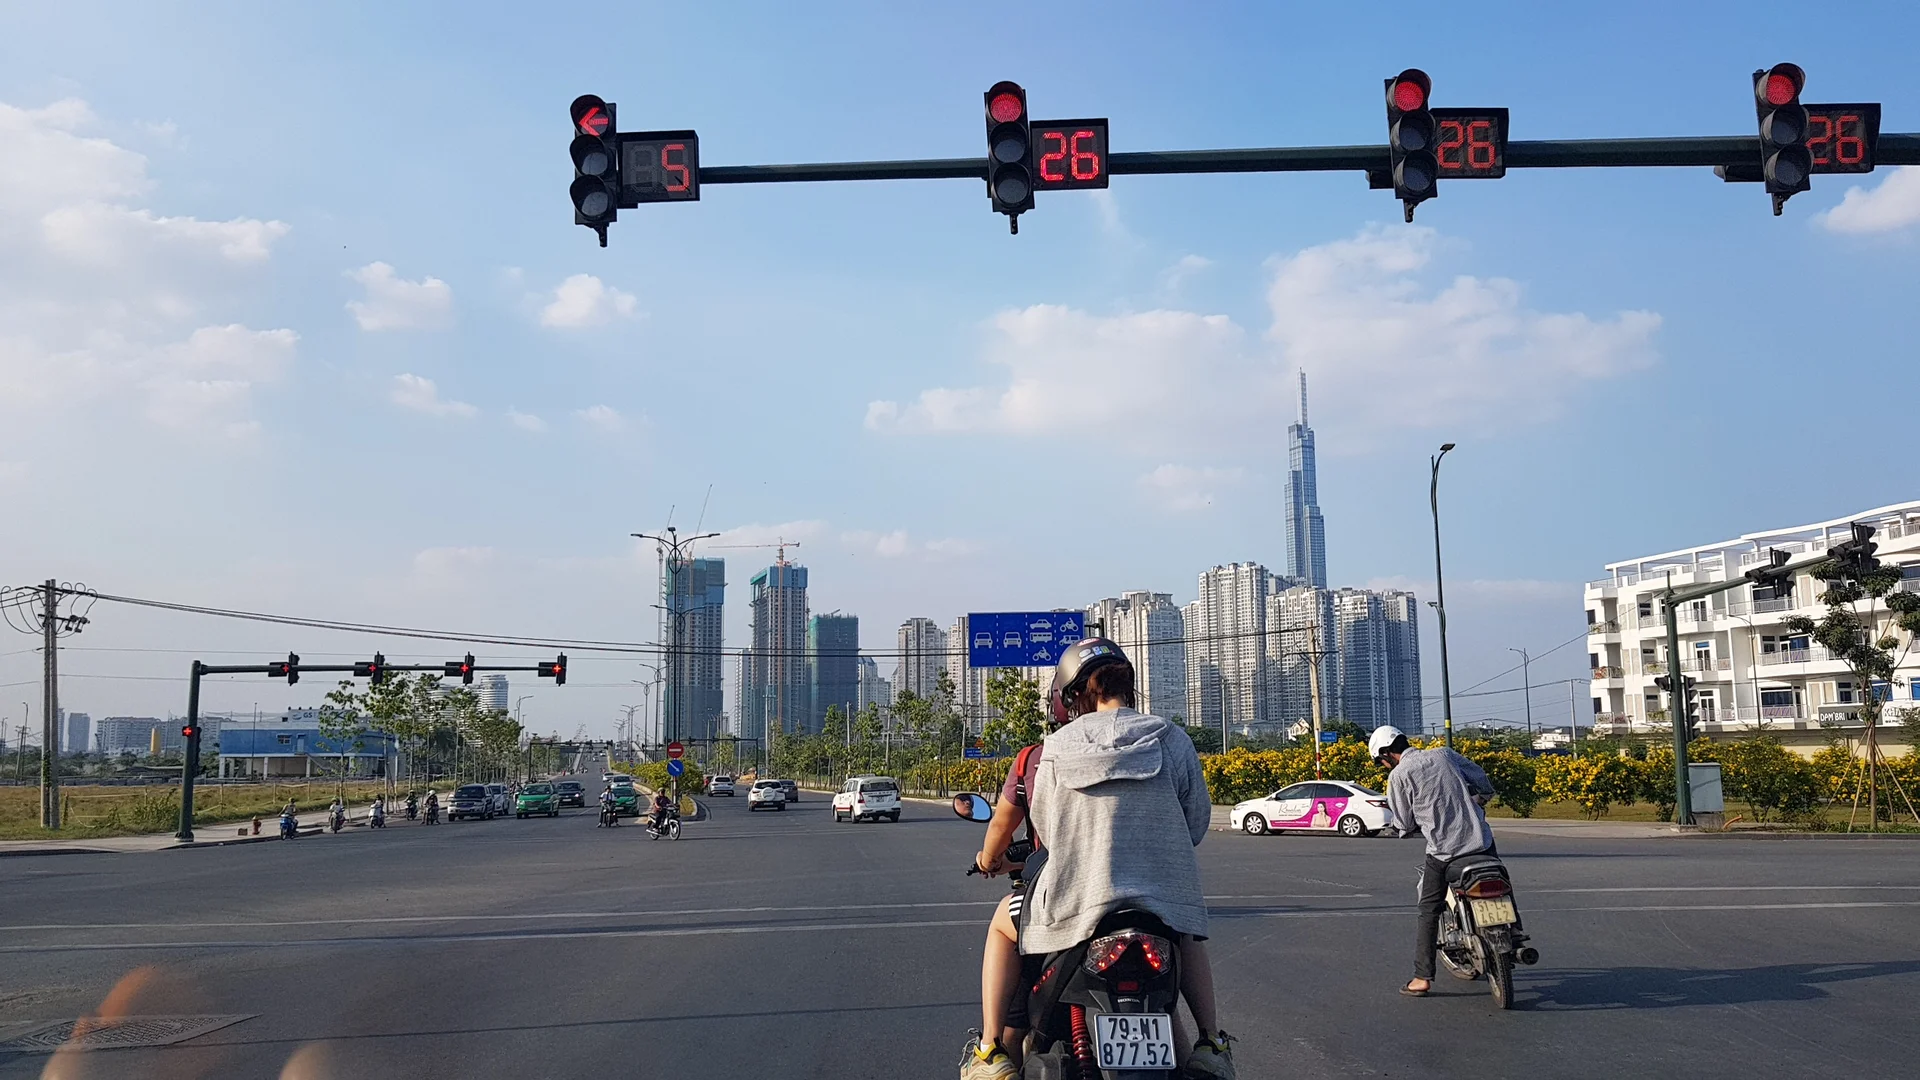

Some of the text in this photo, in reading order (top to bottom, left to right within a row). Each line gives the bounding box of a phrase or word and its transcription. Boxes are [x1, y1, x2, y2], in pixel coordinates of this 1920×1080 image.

[1040, 130, 1099, 181] 26
[1437, 120, 1495, 169] 26
[1804, 115, 1864, 164] 26
[661, 143, 690, 192] 5
[1108, 1017, 1160, 1040] 79-N1
[1103, 1042, 1171, 1066] 877.52
